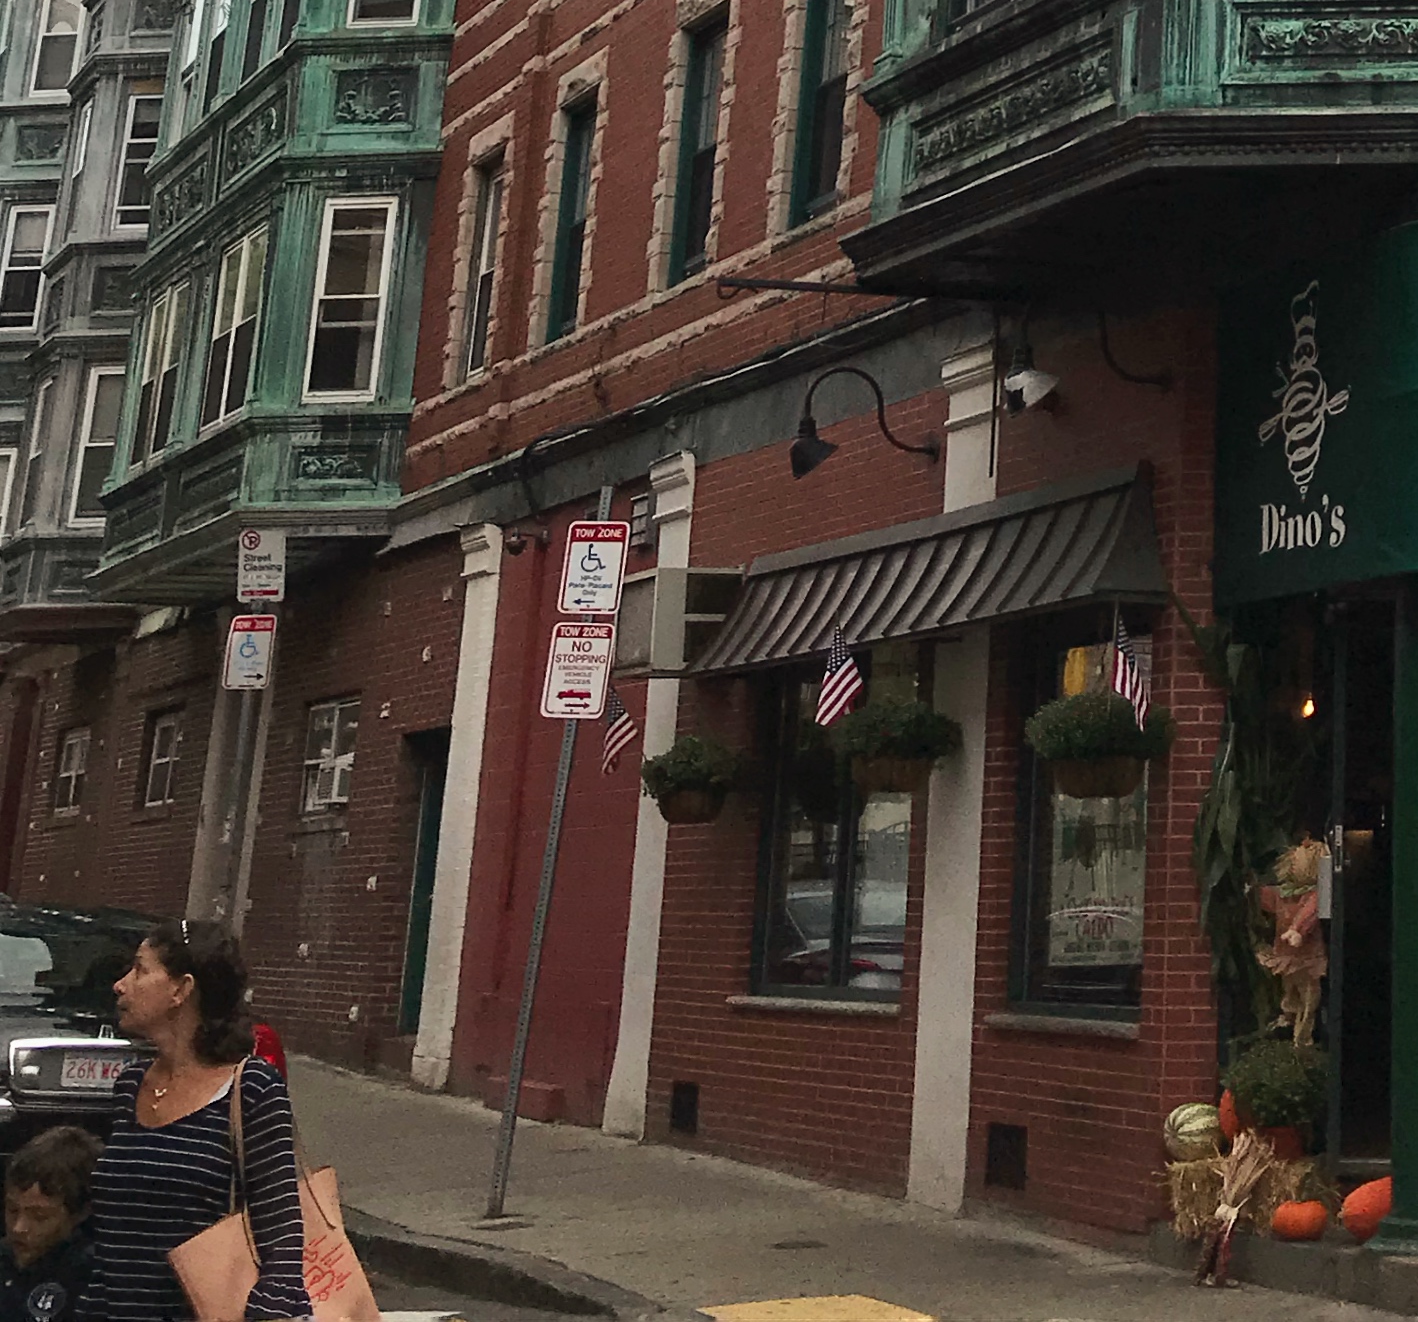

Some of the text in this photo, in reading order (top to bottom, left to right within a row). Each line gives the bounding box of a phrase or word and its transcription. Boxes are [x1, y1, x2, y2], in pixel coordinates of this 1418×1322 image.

[1259, 493, 1347, 555] Dino's
[575, 527, 624, 538] TOW ZONE
[243, 553, 272, 562] Street
[243, 563, 283, 573] Cleaning
[560, 626, 610, 638] TOW ZONE
[571, 640, 593, 653] NO
[555, 653, 606, 664] STOPPING
